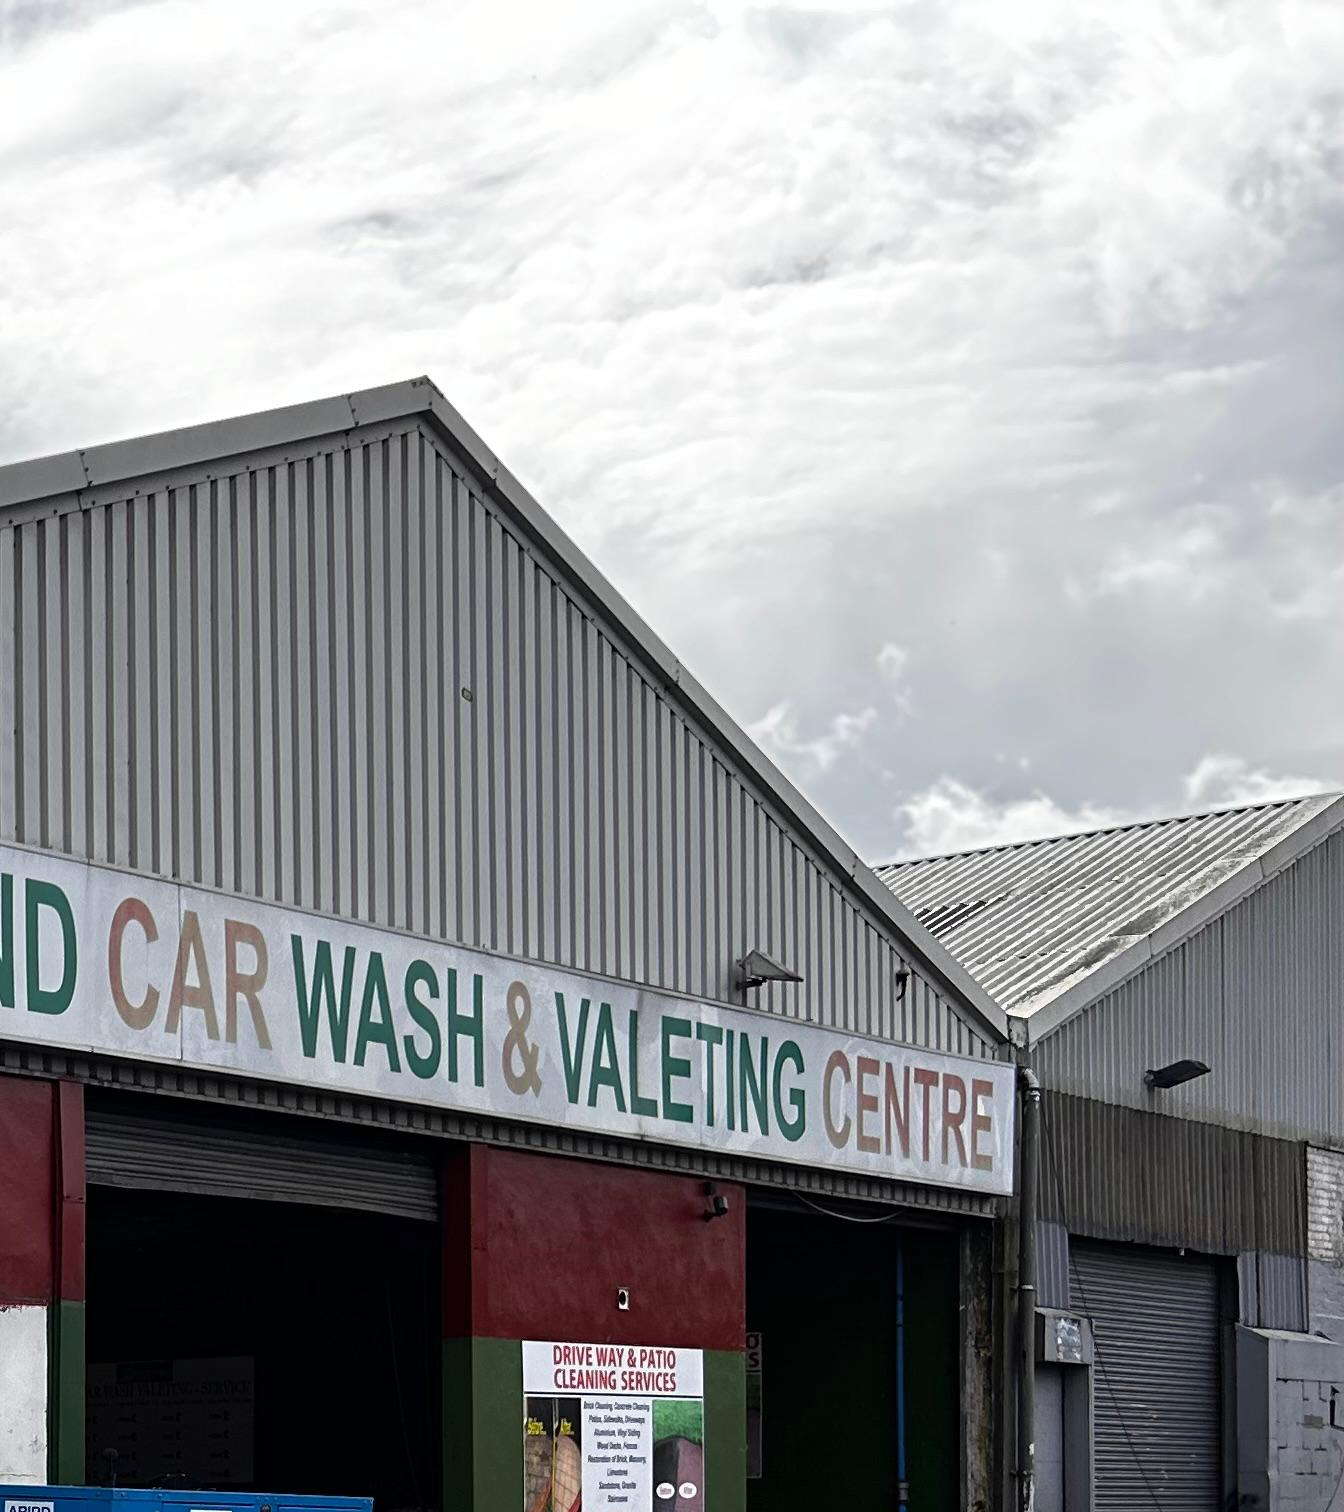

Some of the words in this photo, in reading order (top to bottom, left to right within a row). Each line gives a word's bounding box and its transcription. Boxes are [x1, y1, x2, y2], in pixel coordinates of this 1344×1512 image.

[108, 896, 273, 1051] CAR
[291, 933, 485, 1088] WASH
[502, 980, 543, 1098] &
[555, 991, 807, 1143] VALETING
[822, 1048, 994, 1172] CENTRE
[553, 1345, 593, 1366] DRIVE
[595, 1347, 624, 1368] WAY
[627, 1349, 637, 1368] &
[639, 1350, 676, 1370] PATIO
[553, 1368, 617, 1391] CLEANING
[621, 1371, 677, 1392] SERVICES
